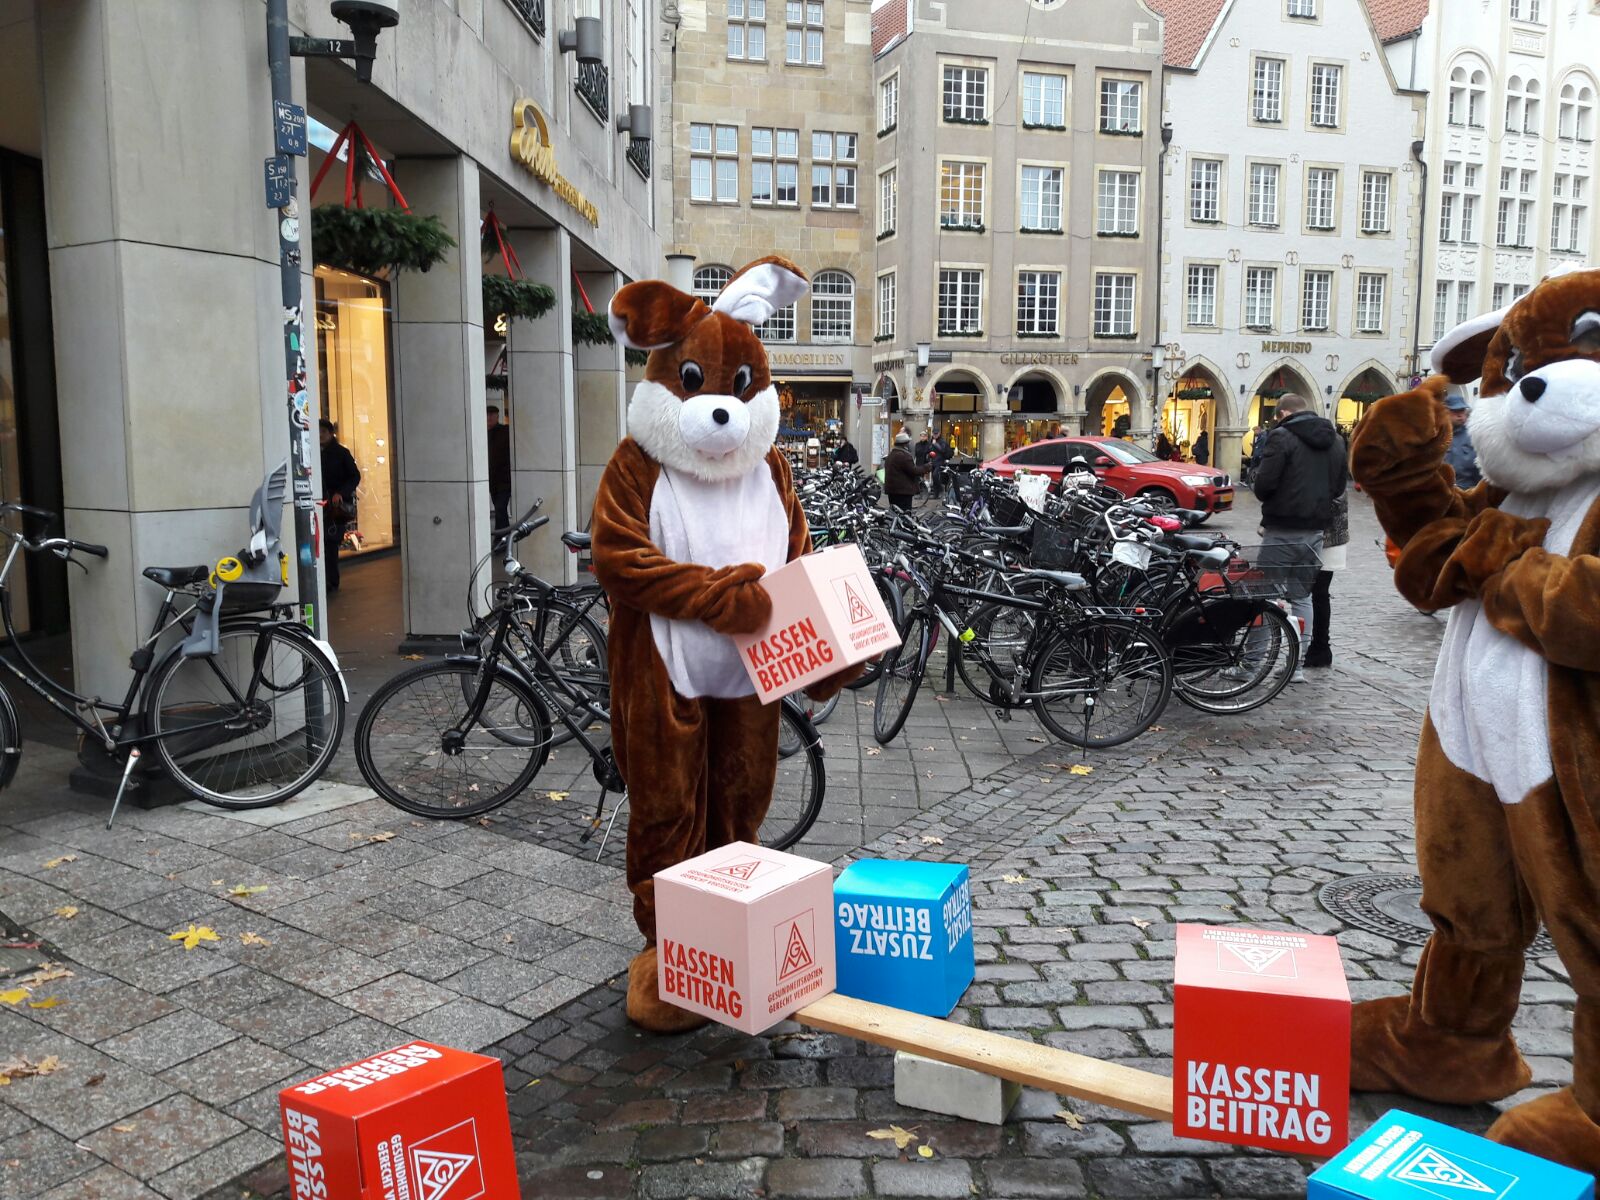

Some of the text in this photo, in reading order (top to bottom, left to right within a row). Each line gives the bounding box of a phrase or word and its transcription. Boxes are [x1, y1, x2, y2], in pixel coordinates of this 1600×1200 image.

[329, 40, 341, 53] 12
[278, 107, 292, 121] MS
[268, 164, 275, 176] S
[1261, 341, 1313, 354] MEPHISTO
[747, 617, 818, 669] KASSEN
[757, 639, 834, 693] BEITRAG
[838, 902, 931, 934] BEITRAG
[943, 878, 969, 930] BEITRAG
[849, 929, 934, 960] ZUSATZ
[947, 903, 971, 954] ZUSATZ
[663, 938, 735, 988] KASSEN
[767, 966, 823, 1003] GESUNDHEITSKOSTEN
[664, 966, 743, 1019] BEITRAG
[768, 977, 823, 1014] GERECHT VERTEILEN!
[295, 1044, 423, 1095] NEHMER
[341, 1048, 443, 1092] ARBEIT
[1187, 1060, 1320, 1108] KASSEN
[1187, 1095, 1332, 1145] BEITRAG
[285, 1107, 312, 1200] BEITR
[302, 1113, 328, 1200] KASS
[377, 1141, 394, 1189] GERECHT
